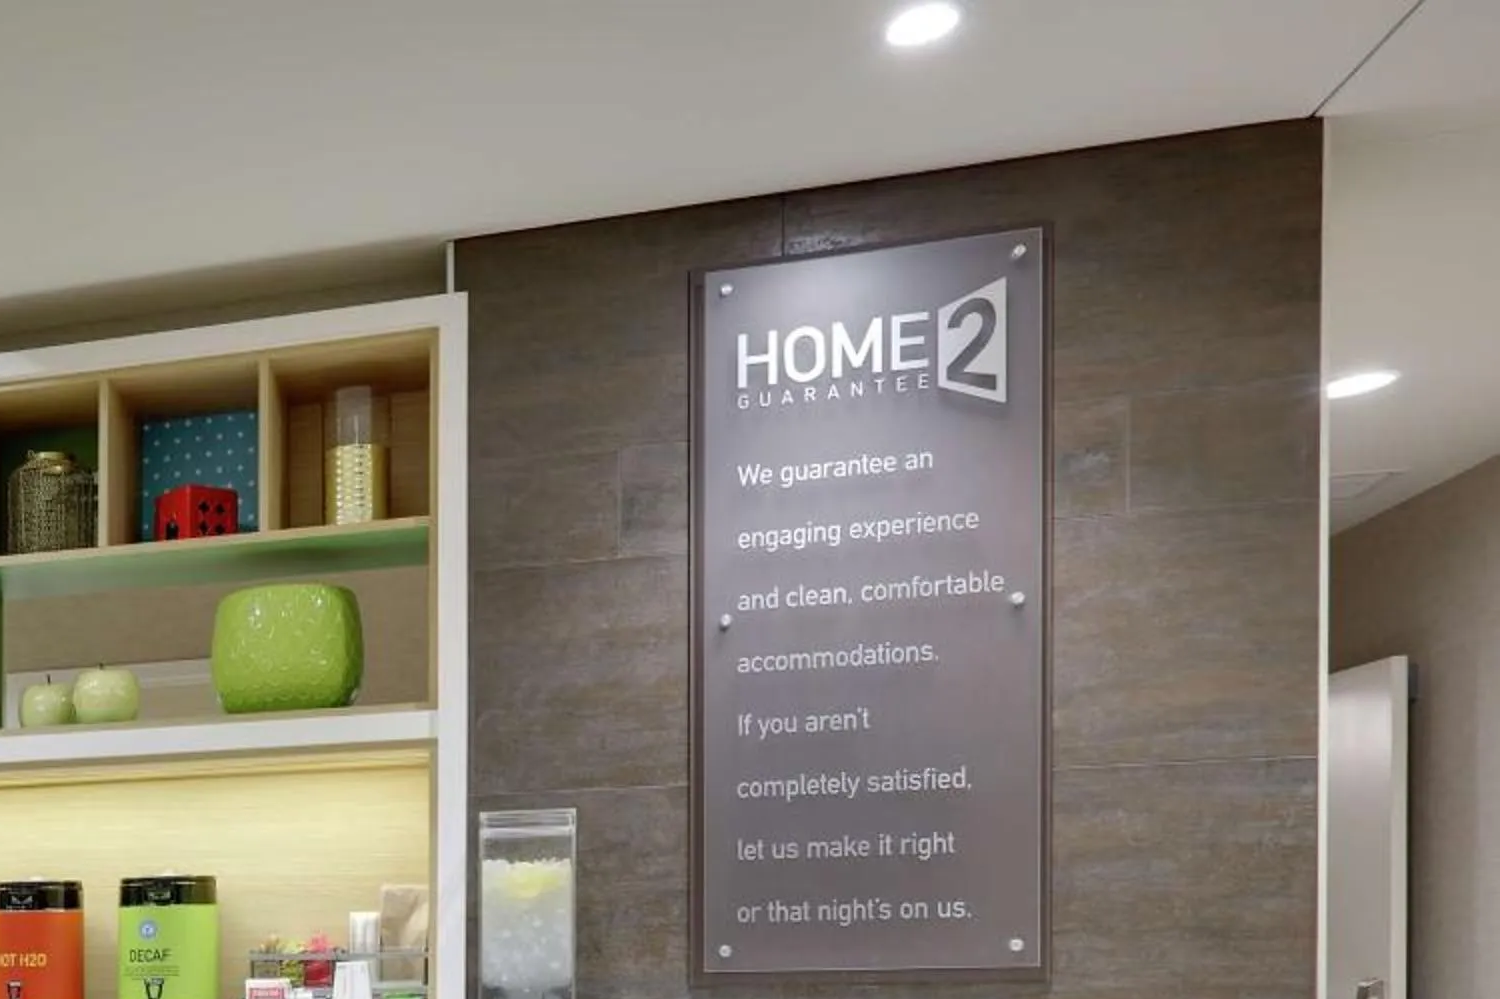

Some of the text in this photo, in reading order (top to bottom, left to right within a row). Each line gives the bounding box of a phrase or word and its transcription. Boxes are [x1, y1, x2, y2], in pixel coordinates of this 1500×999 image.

[737, 311, 930, 389] HOME
[737, 373, 930, 410] GUARANTEE
[737, 450, 934, 489] We guarantee an
[737, 510, 980, 553] engaging experience
[737, 570, 1005, 611] and clean, comfortable
[737, 641, 940, 674] accommodations.
[738, 707, 871, 740] If you aren't
[737, 772, 860, 801] completely
[737, 831, 957, 861] let us make it right
[737, 898, 973, 926] or that night's on us.
[129, 948, 173, 963] DECAF
